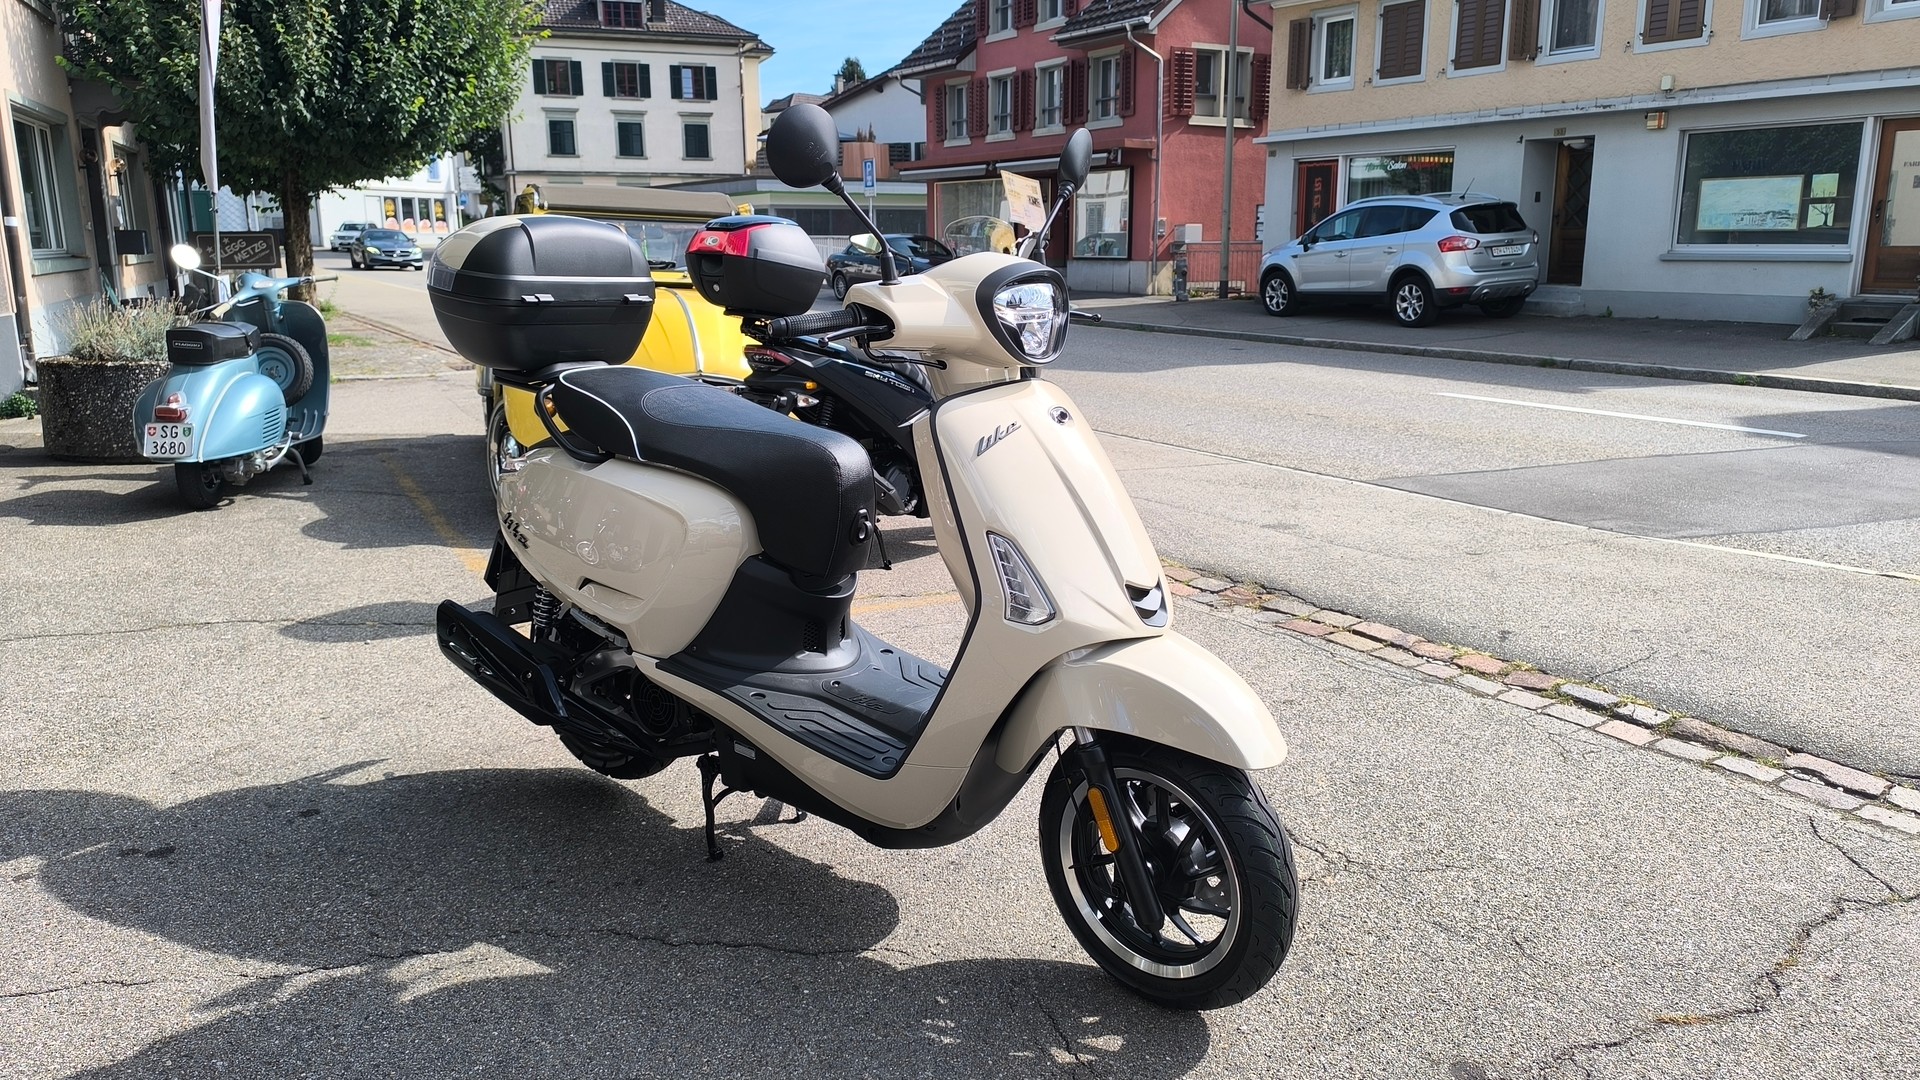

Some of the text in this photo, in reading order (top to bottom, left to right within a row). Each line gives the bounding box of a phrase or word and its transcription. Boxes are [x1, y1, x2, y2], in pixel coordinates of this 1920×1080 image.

[1387, 160, 1408, 171] Salon
[209, 238, 247, 260] TLEGG
[233, 240, 267, 263] METZG
[160, 425, 179, 439] SG
[151, 441, 186, 455] 3680
